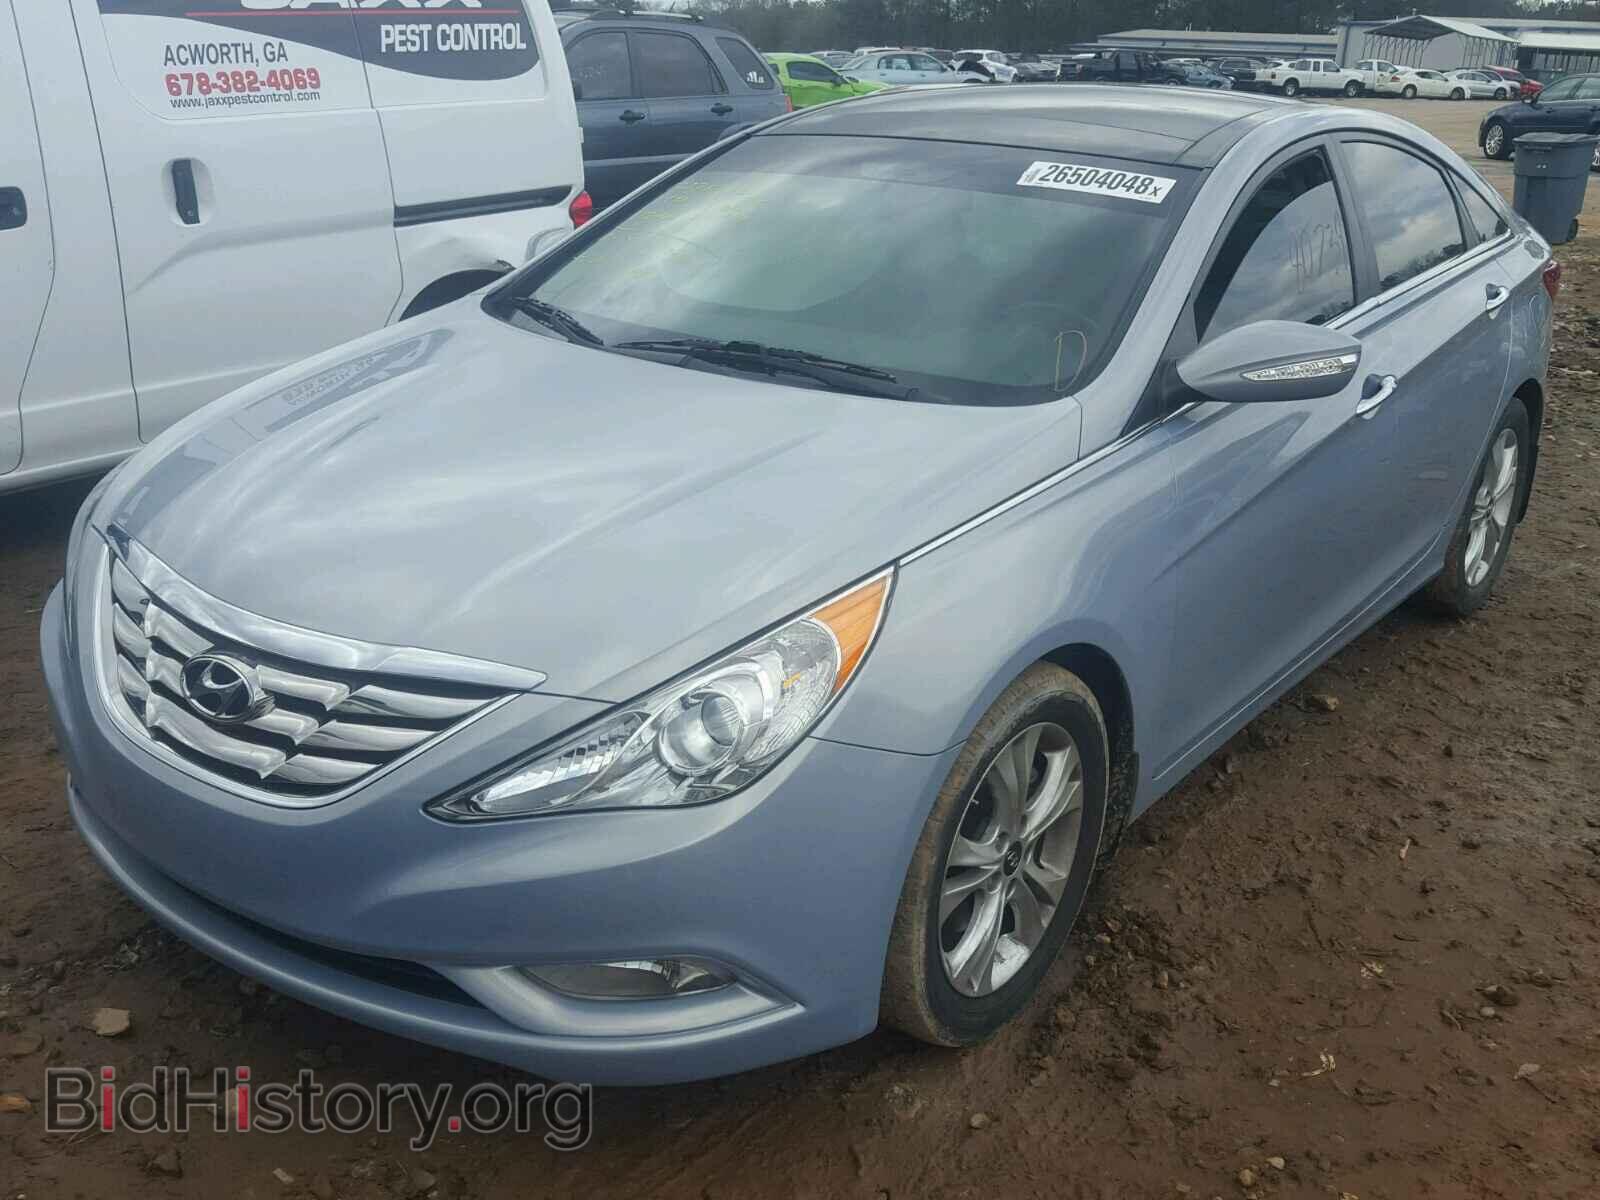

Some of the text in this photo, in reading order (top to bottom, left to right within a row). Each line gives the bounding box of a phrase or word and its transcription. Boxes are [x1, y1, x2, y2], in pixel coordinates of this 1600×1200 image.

[380, 22, 527, 52] PEST CONTROL
[163, 41, 289, 67] ACWORTH, GA
[165, 67, 321, 97] 678-382-4069
[170, 91, 321, 108] www.jaxxpestcontrol.com
